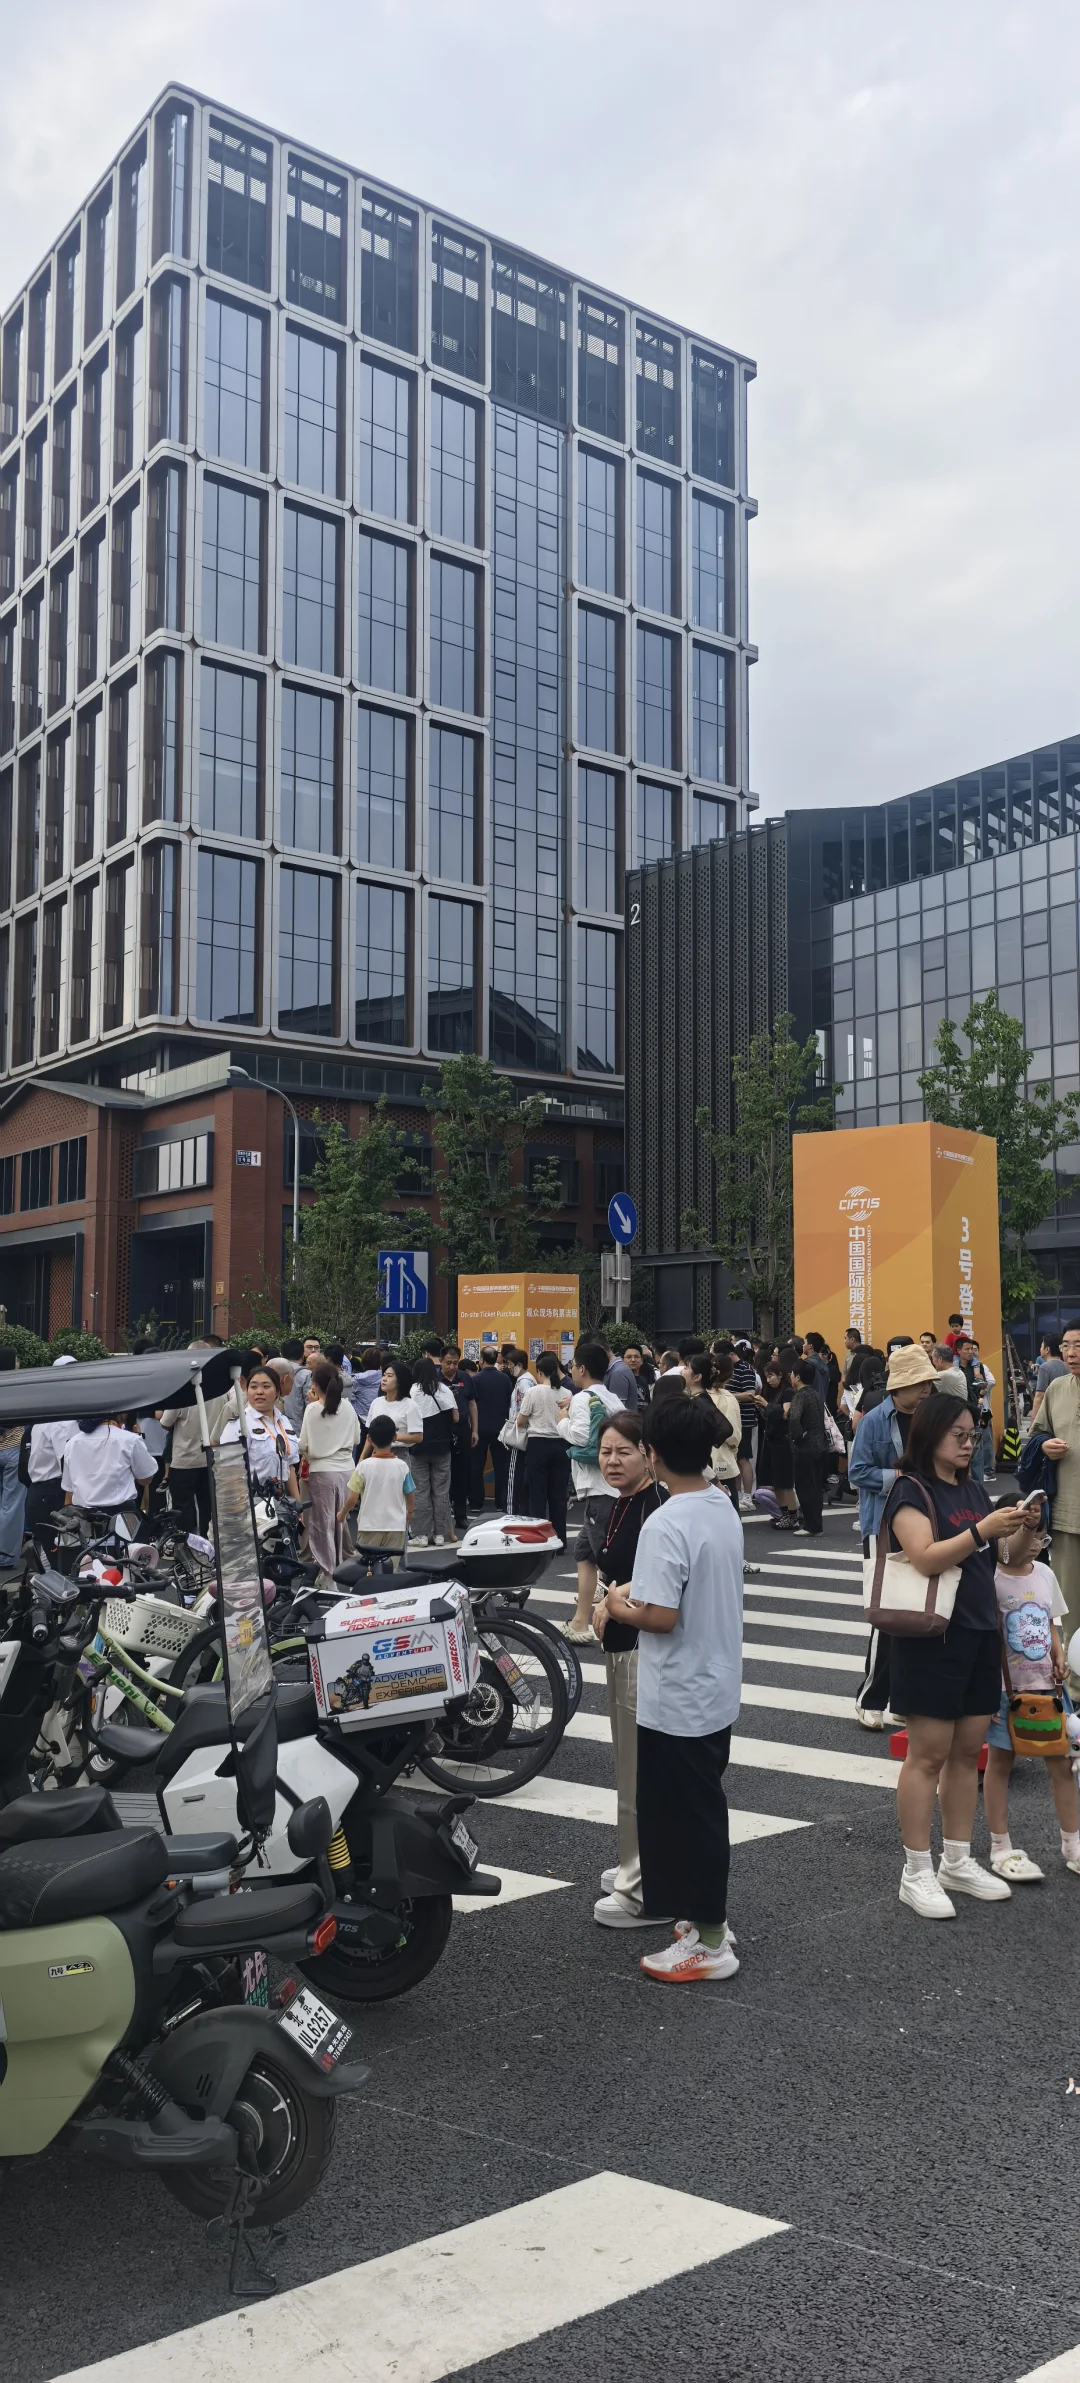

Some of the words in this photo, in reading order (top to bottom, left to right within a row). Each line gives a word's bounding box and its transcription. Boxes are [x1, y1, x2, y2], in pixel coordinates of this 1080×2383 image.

[630, 903, 640, 926] 2
[838, 1198, 880, 1210] CIFTIS
[848, 1226, 866, 1344] 中国国际服务贸
[526, 1308, 578, 1318] 观众现场购票流程
[340, 1616, 376, 1627] SUPER
[346, 1615, 416, 1632] ADVENTURE
[372, 1634, 411, 1654] GS
[376, 1646, 432, 1660] ADVENTURE
[450, 1646, 460, 1669] RACE
[374, 1664, 443, 1683] ADVENTURE
[376, 1682, 445, 1699] EXPERIENCE
[390, 1676, 428, 1689] DEMO
[339, 1923, 359, 1932] TCS
[672, 1951, 708, 1972] TERREX
[298, 2006, 332, 2049] UL6257
